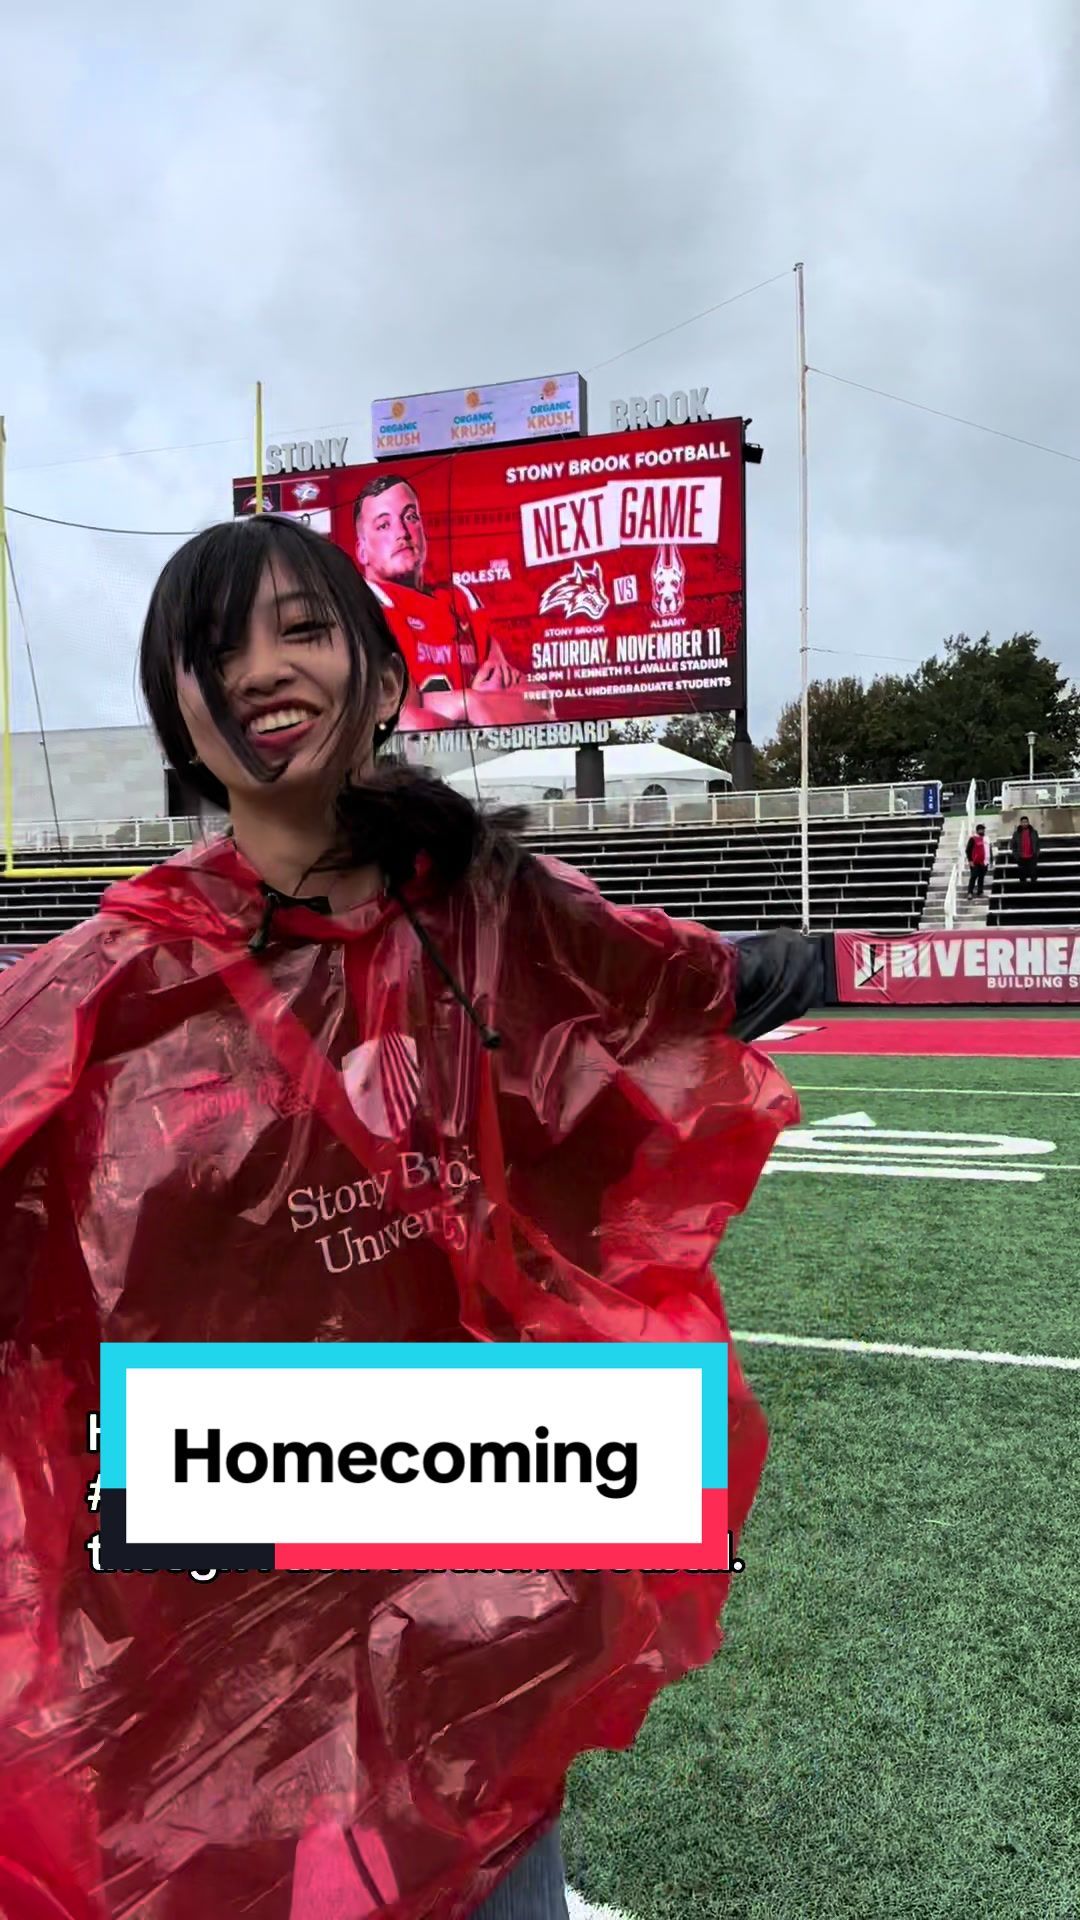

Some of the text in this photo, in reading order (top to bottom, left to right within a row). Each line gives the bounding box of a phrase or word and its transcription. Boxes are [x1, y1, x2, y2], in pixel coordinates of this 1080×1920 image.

[530, 401, 571, 414] ORGANIC
[609, 387, 711, 433] BROOK
[454, 412, 493, 424] ORGANIC
[527, 412, 575, 429] KRUSH
[380, 421, 417, 434] ORGANIC
[451, 422, 496, 439] KRUSH
[376, 433, 421, 449] KRUSH
[266, 437, 348, 475] STONY
[506, 441, 731, 484] STONY BROOK FOOTBALL
[533, 485, 705, 558] NEXT GAME
[452, 568, 512, 585] BOLESTA
[617, 579, 633, 601] VS
[544, 625, 605, 637] STONY BROOK
[651, 618, 686, 628] ALBANY
[616, 629, 702, 663] NOVEMBER
[708, 628, 721, 656] 11
[549, 670, 563, 681] PM
[574, 665, 621, 679] KENNETH
[634, 661, 678, 675] LAVALLE
[680, 657, 728, 670] STADIUM
[550, 688, 563, 698] TO
[565, 685, 584, 697] ALL
[585, 681, 675, 696] UNDERGRADUATE
[676, 676, 731, 691] STUDENTS
[420, 730, 479, 751] FAMILY
[488, 720, 610, 749] SCOREBOARD
[987, 976, 1080, 989] BUILDING S
